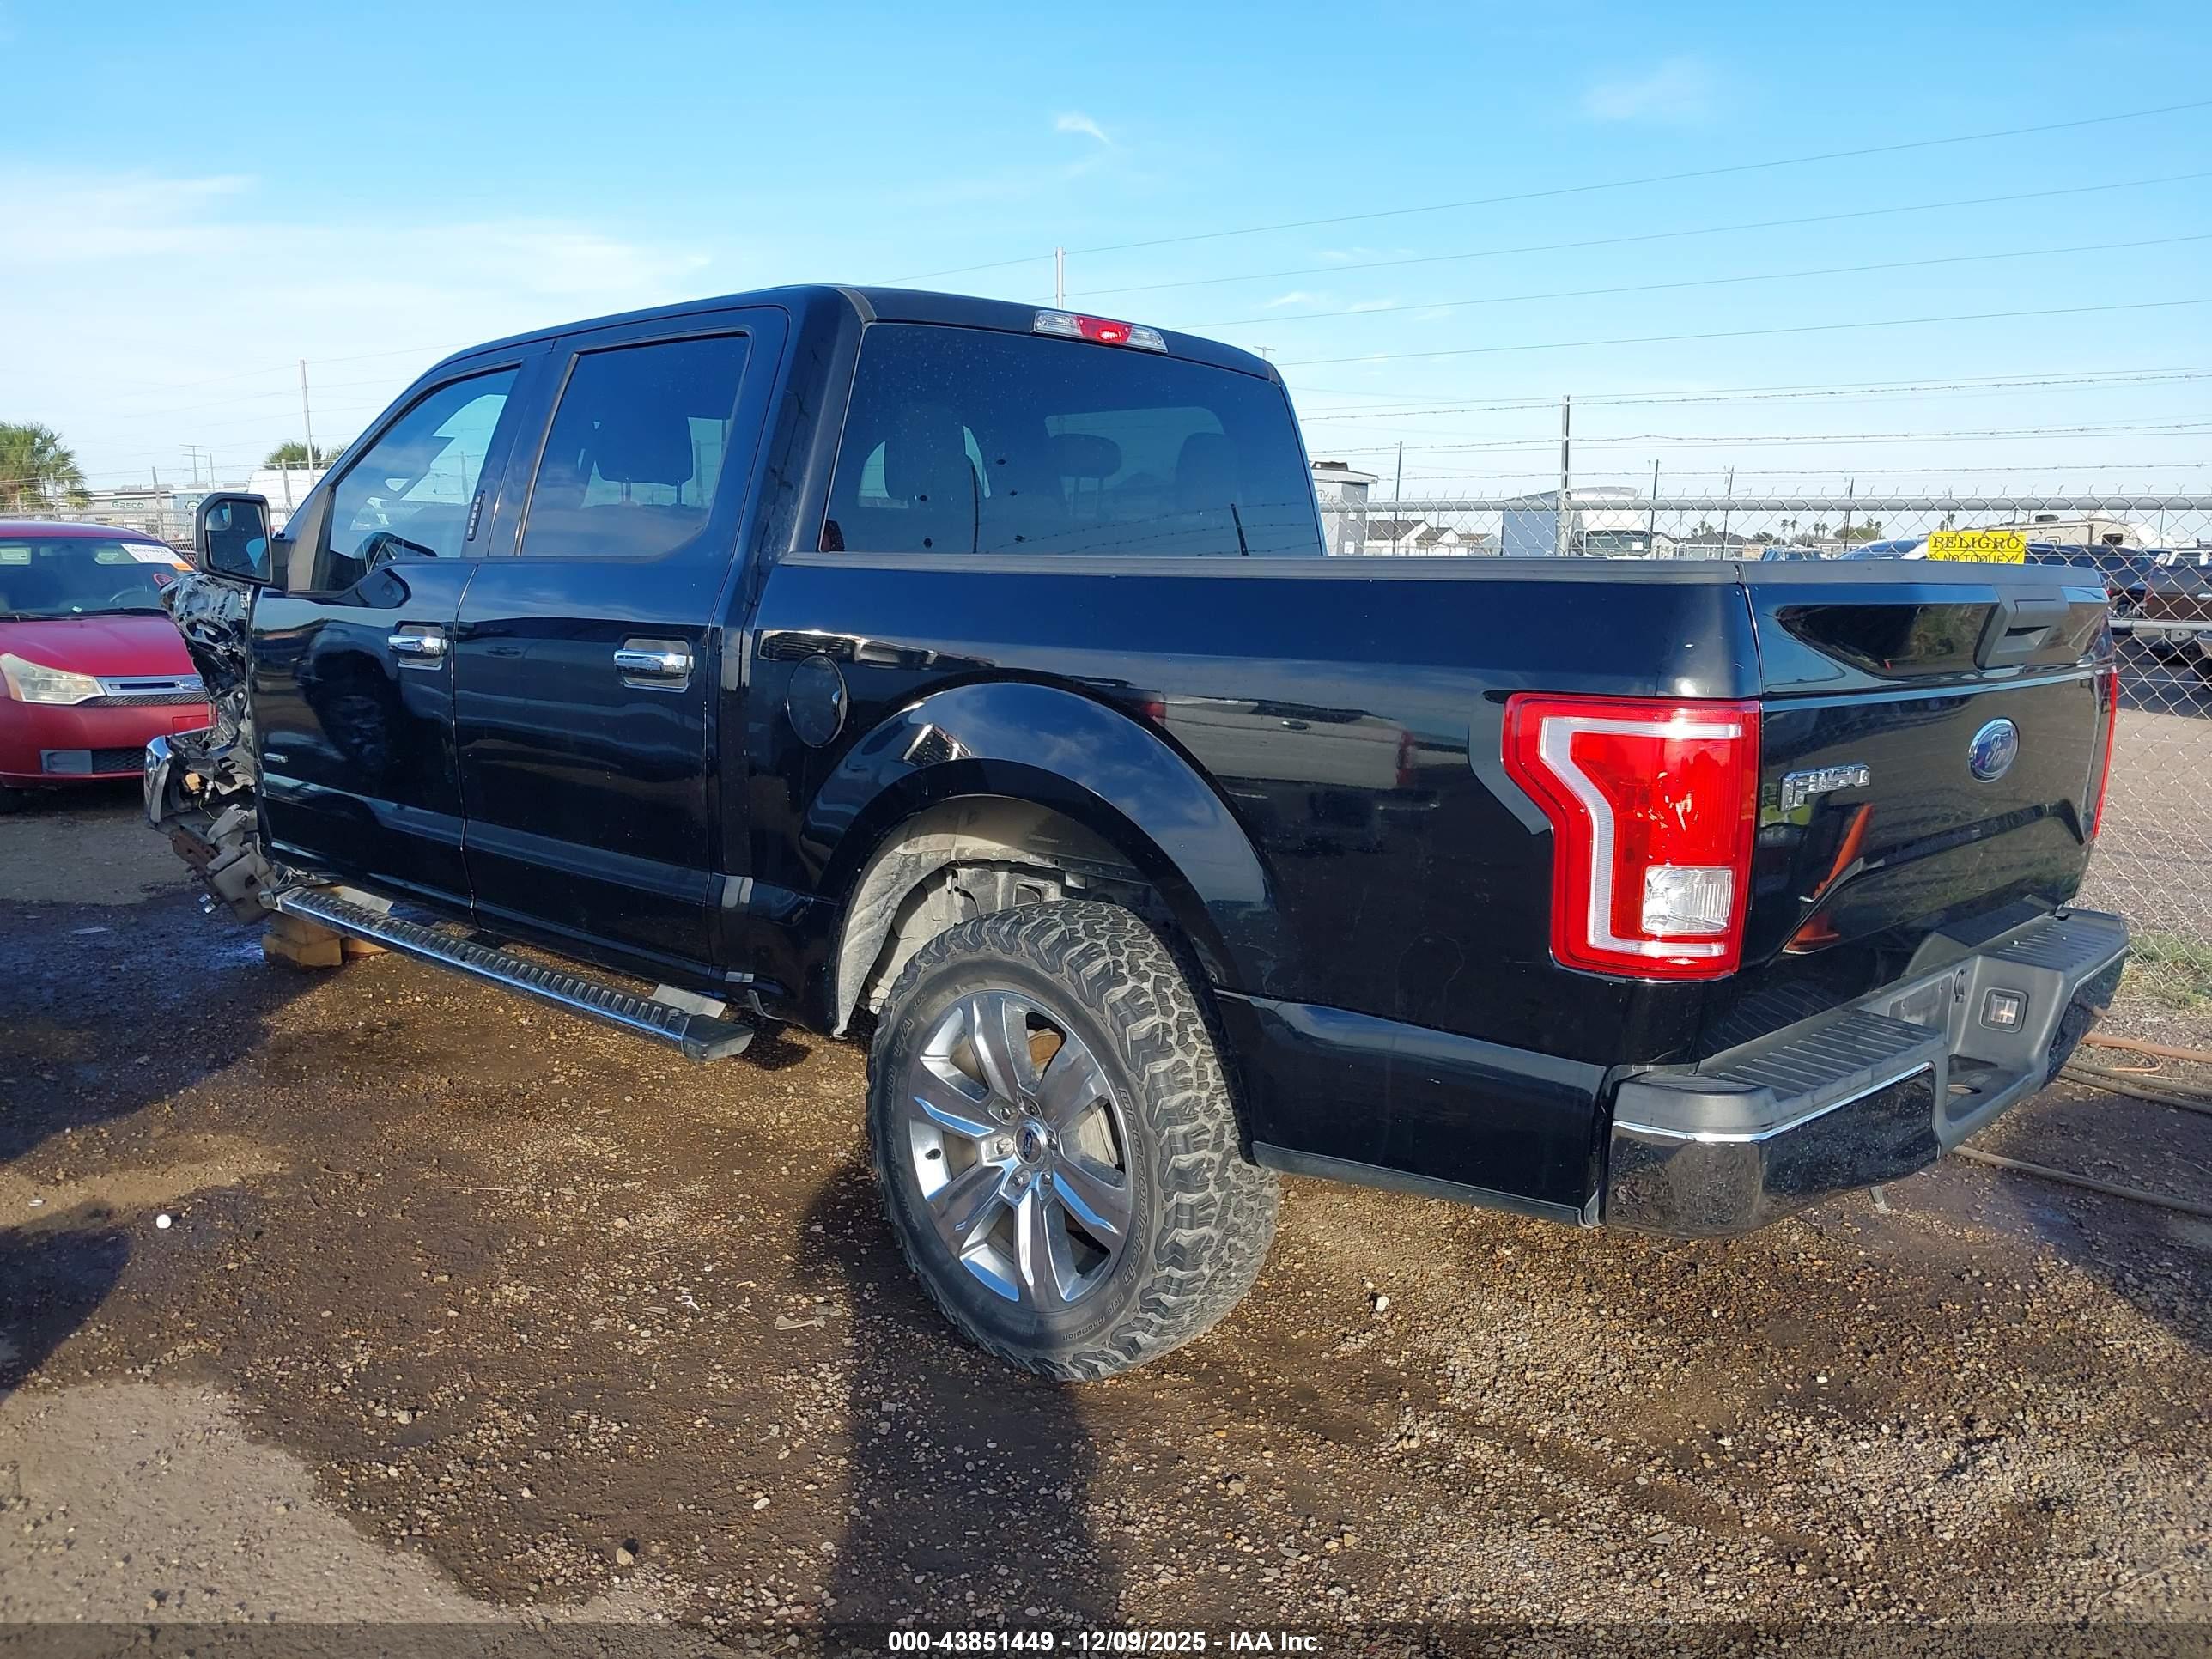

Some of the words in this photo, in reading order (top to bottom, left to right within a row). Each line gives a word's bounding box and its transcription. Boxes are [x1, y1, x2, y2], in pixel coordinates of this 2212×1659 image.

[112, 501, 145, 509] GRECO
[1931, 534, 2021, 550] PELIGRO
[1062, 1316, 1106, 1340] Champion
